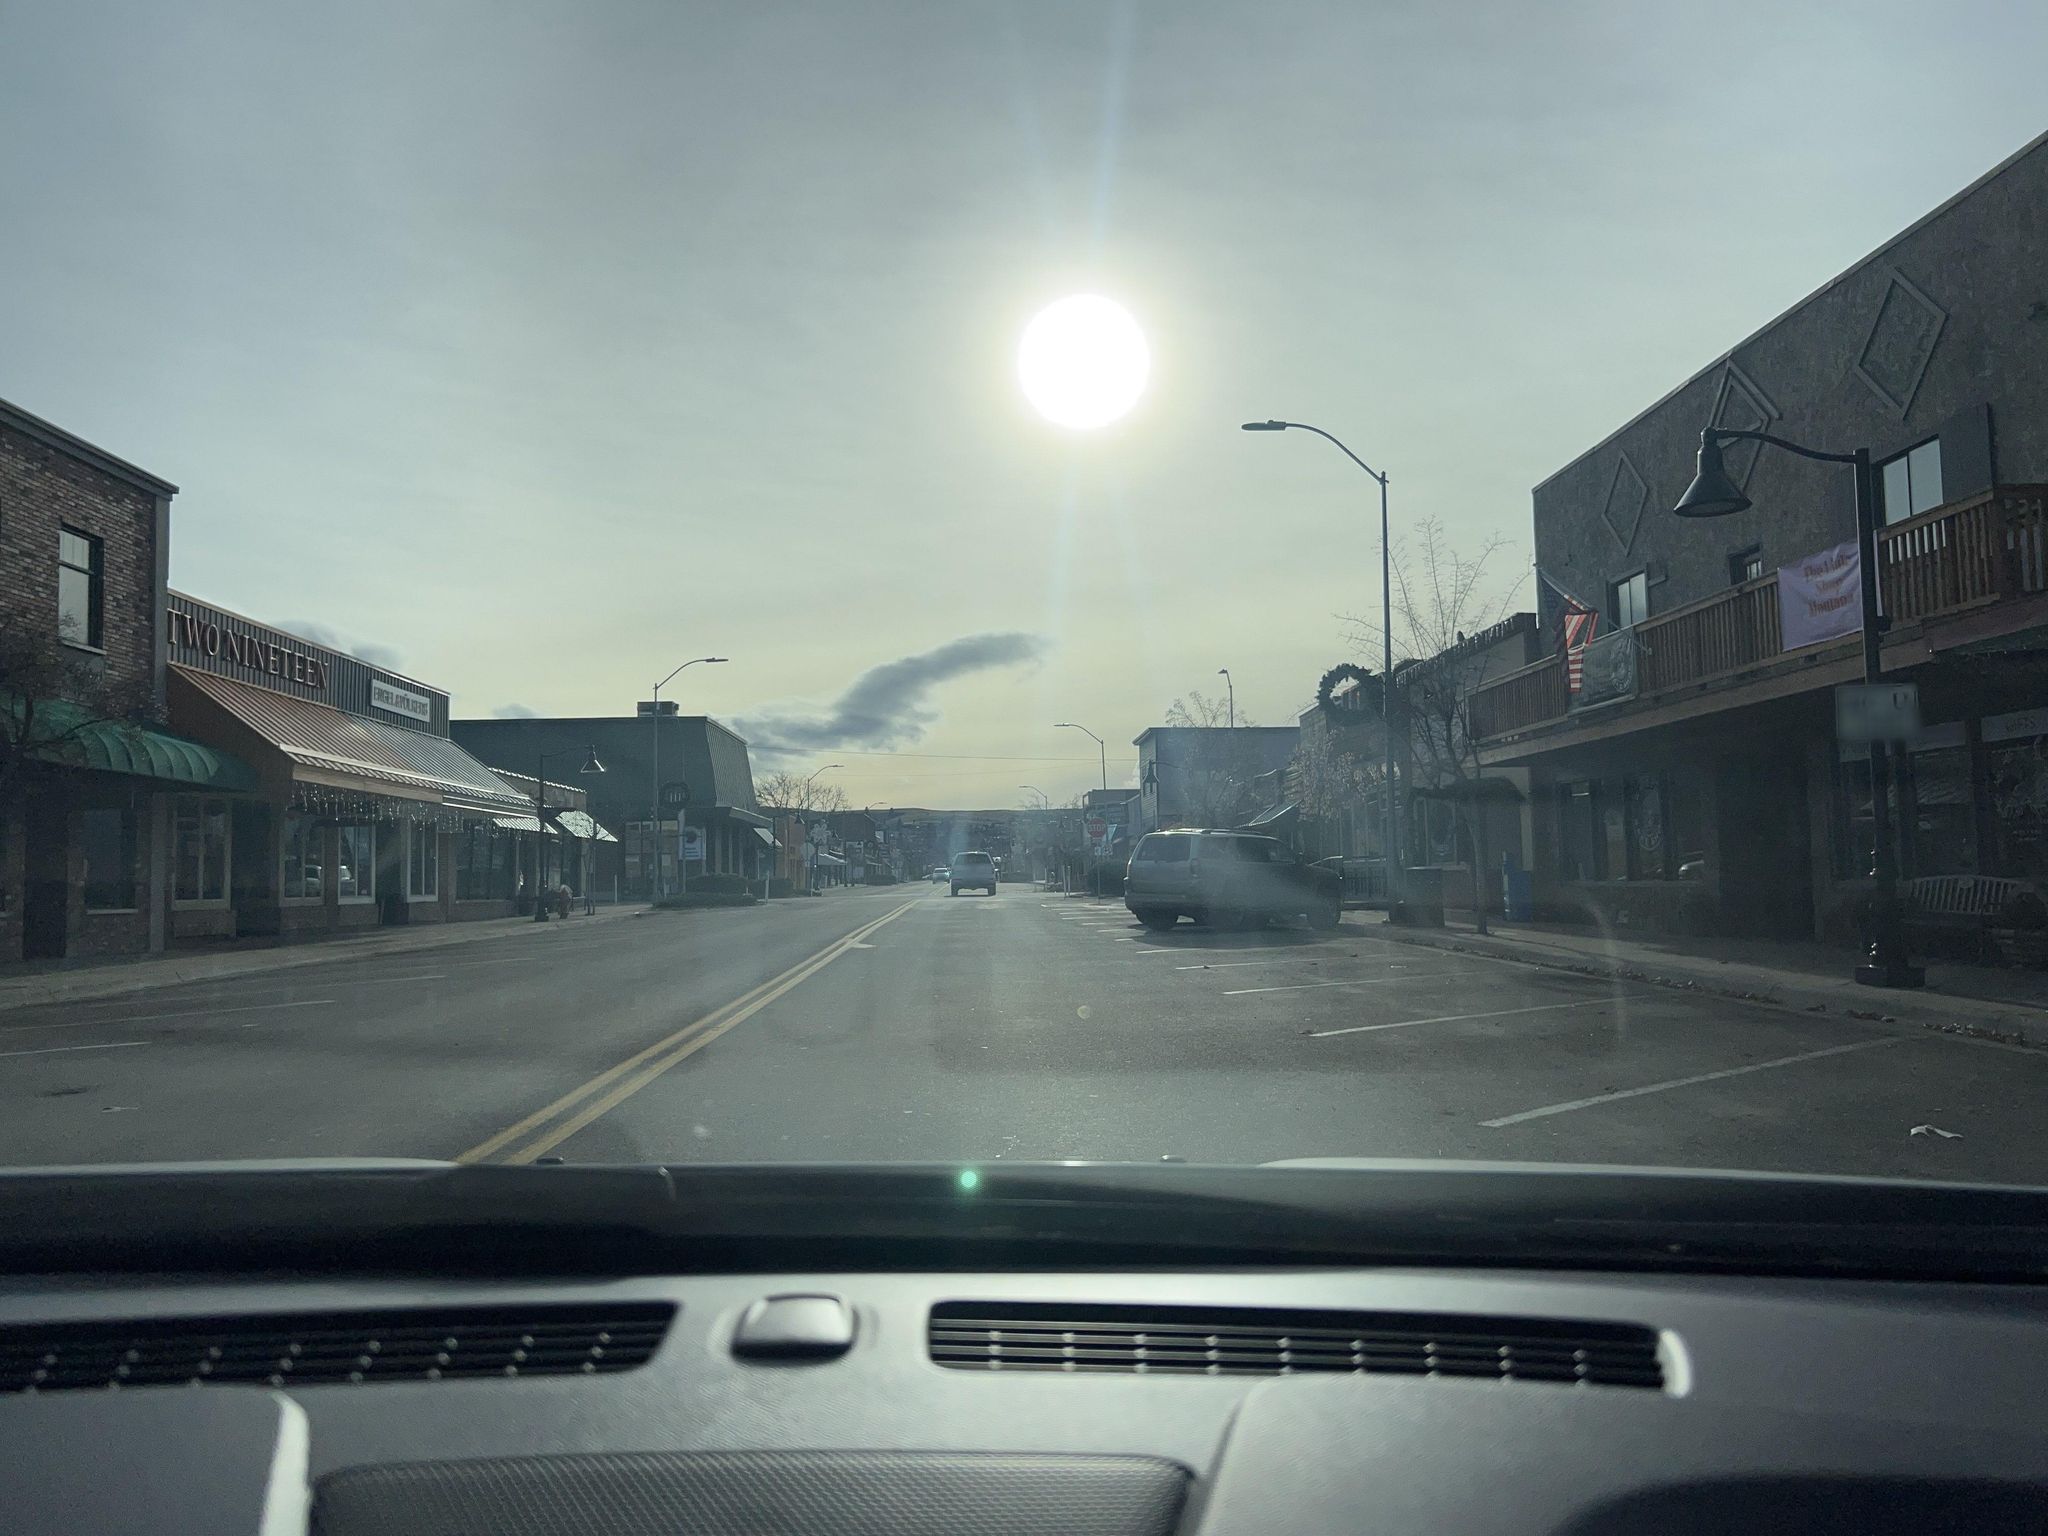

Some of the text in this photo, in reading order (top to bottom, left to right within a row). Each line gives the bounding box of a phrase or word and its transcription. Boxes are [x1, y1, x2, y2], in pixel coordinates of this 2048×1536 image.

[167, 608, 329, 689] TWO NINETEEN
[1088, 823, 1106, 832] STOP
